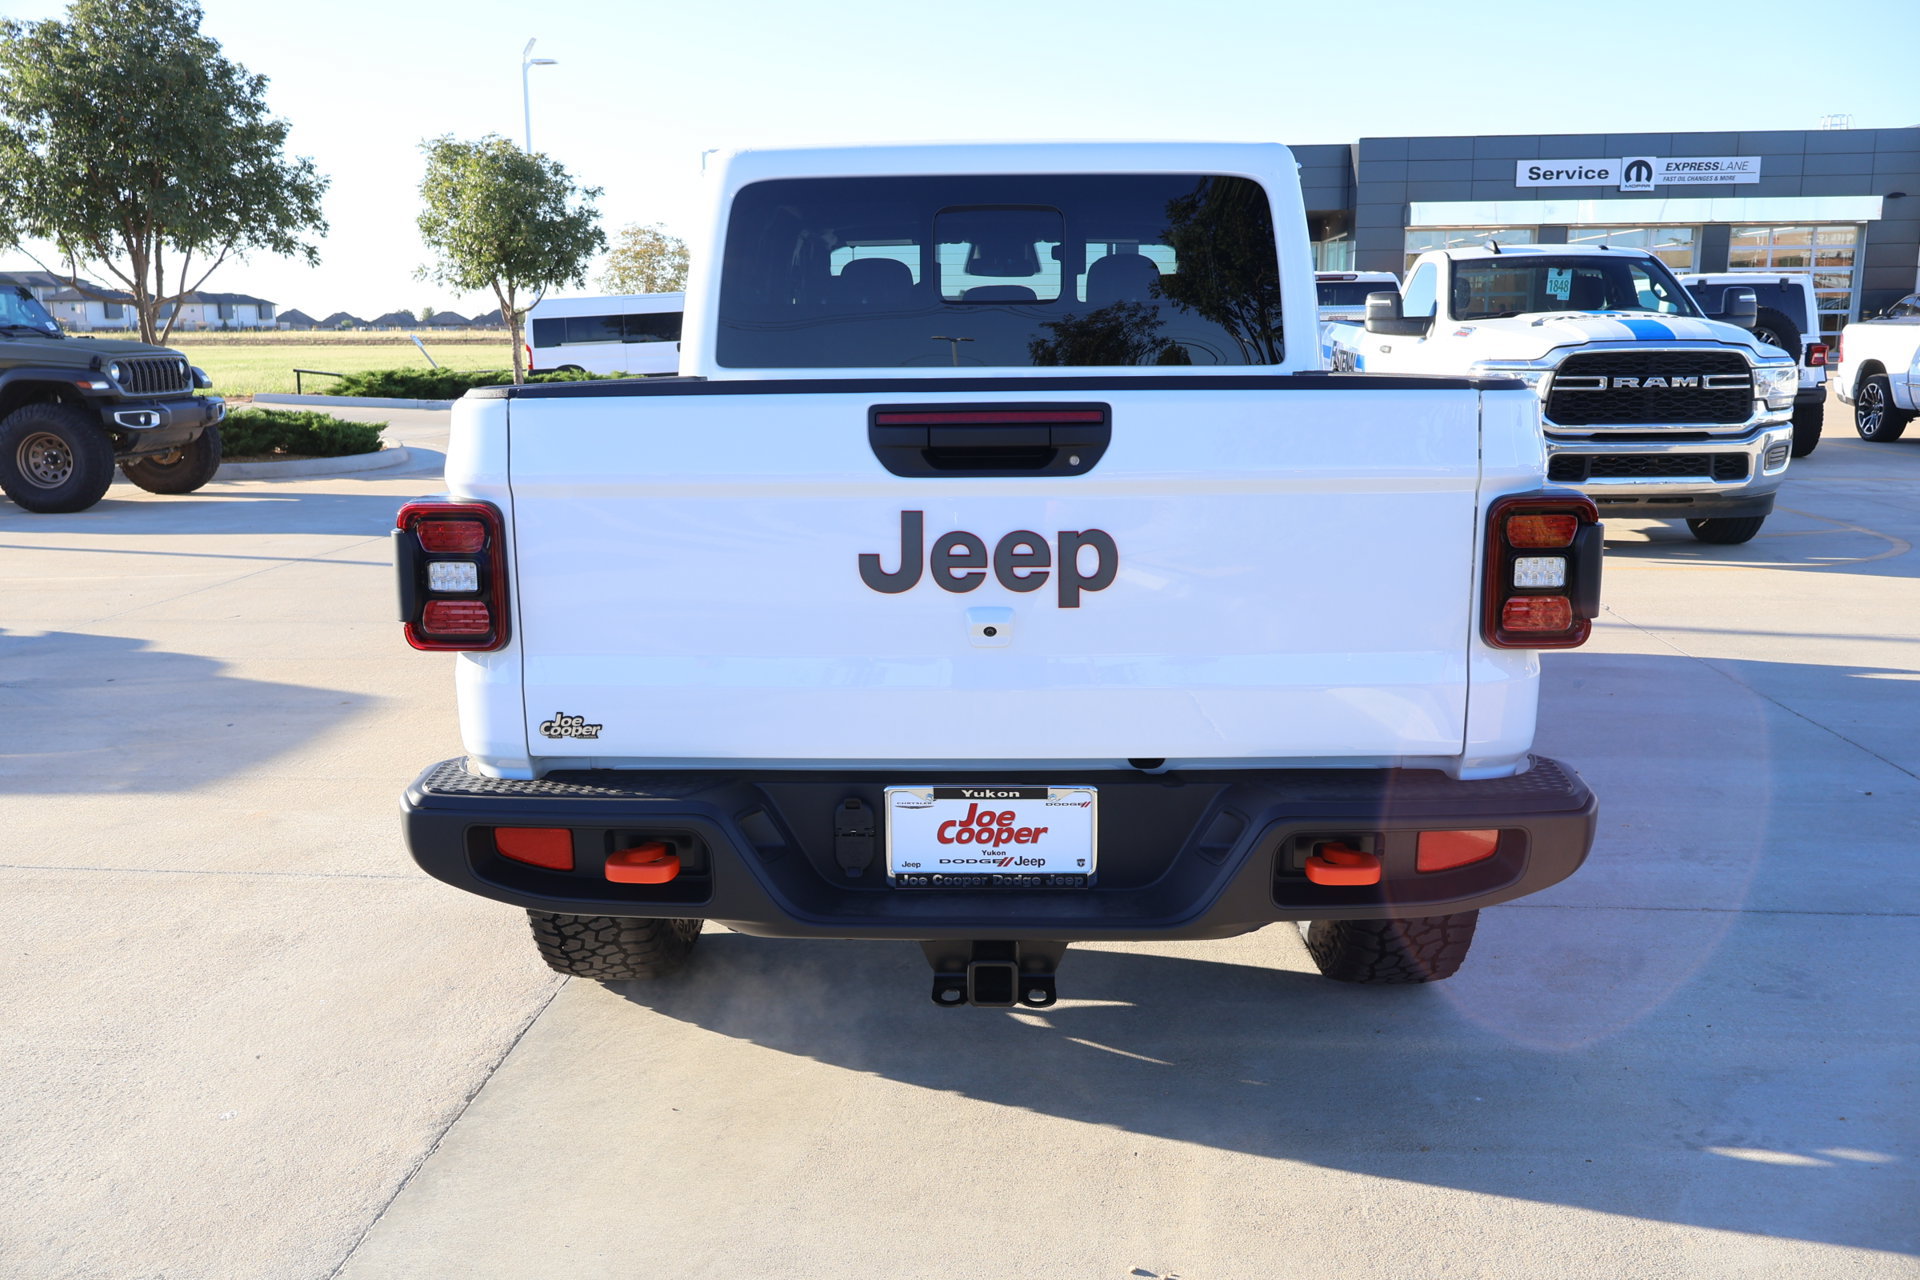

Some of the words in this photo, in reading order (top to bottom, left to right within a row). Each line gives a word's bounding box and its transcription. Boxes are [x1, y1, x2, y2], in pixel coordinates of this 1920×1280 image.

[1528, 165, 1609, 181] Service
[1549, 279, 1570, 293] 1848
[1612, 376, 1699, 388] RAM
[858, 510, 1119, 608] Jeep
[551, 712, 584, 727] Joe
[540, 720, 602, 737] Cooper
[961, 789, 1020, 798] Yukon
[959, 803, 1016, 828] Joe
[937, 820, 1048, 847] Cooper
[901, 861, 921, 869] Jeep
[1014, 856, 1046, 868] Jeep
[899, 875, 928, 885] Joe
[932, 875, 988, 887] Cooper
[992, 875, 1041, 887] Dodge
[1046, 875, 1084, 887] Jeep
